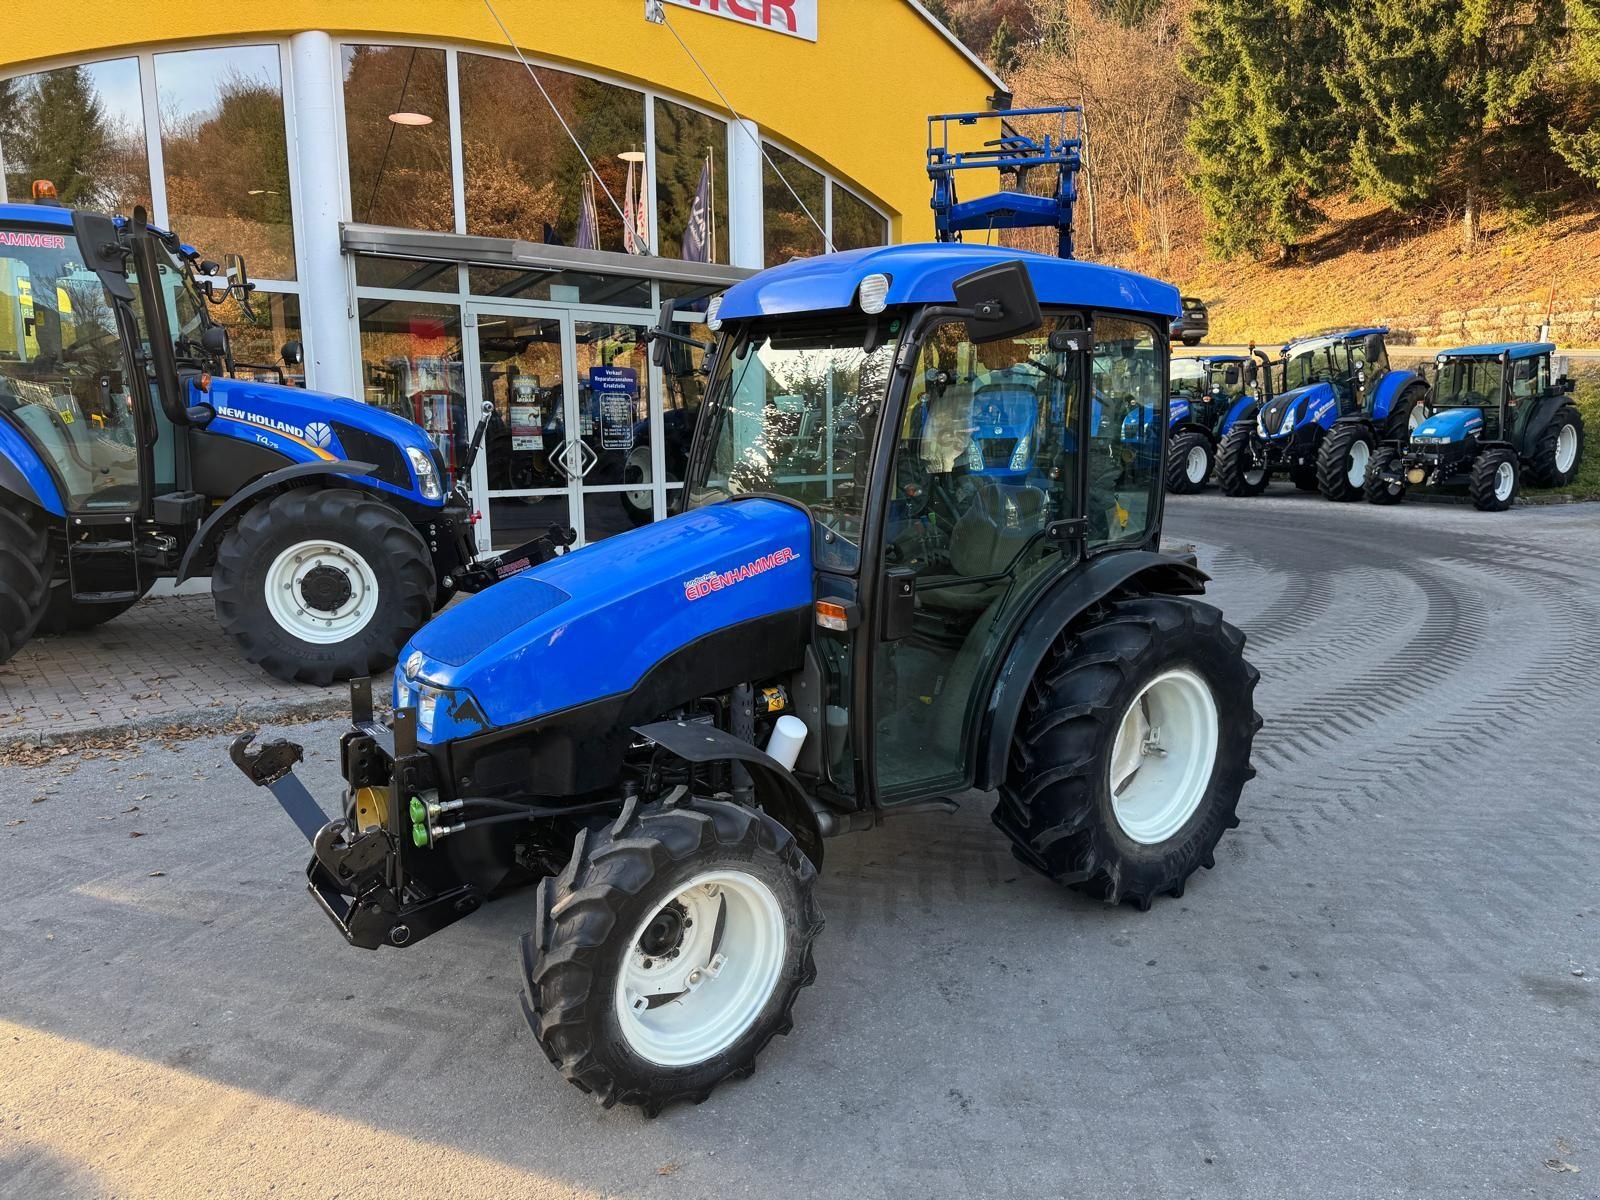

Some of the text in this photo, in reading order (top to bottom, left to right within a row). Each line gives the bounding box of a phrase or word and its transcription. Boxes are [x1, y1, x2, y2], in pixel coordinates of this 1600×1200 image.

[217, 406, 304, 438] NEW HOLLAND
[685, 547, 793, 601] EIDENHAMMER
